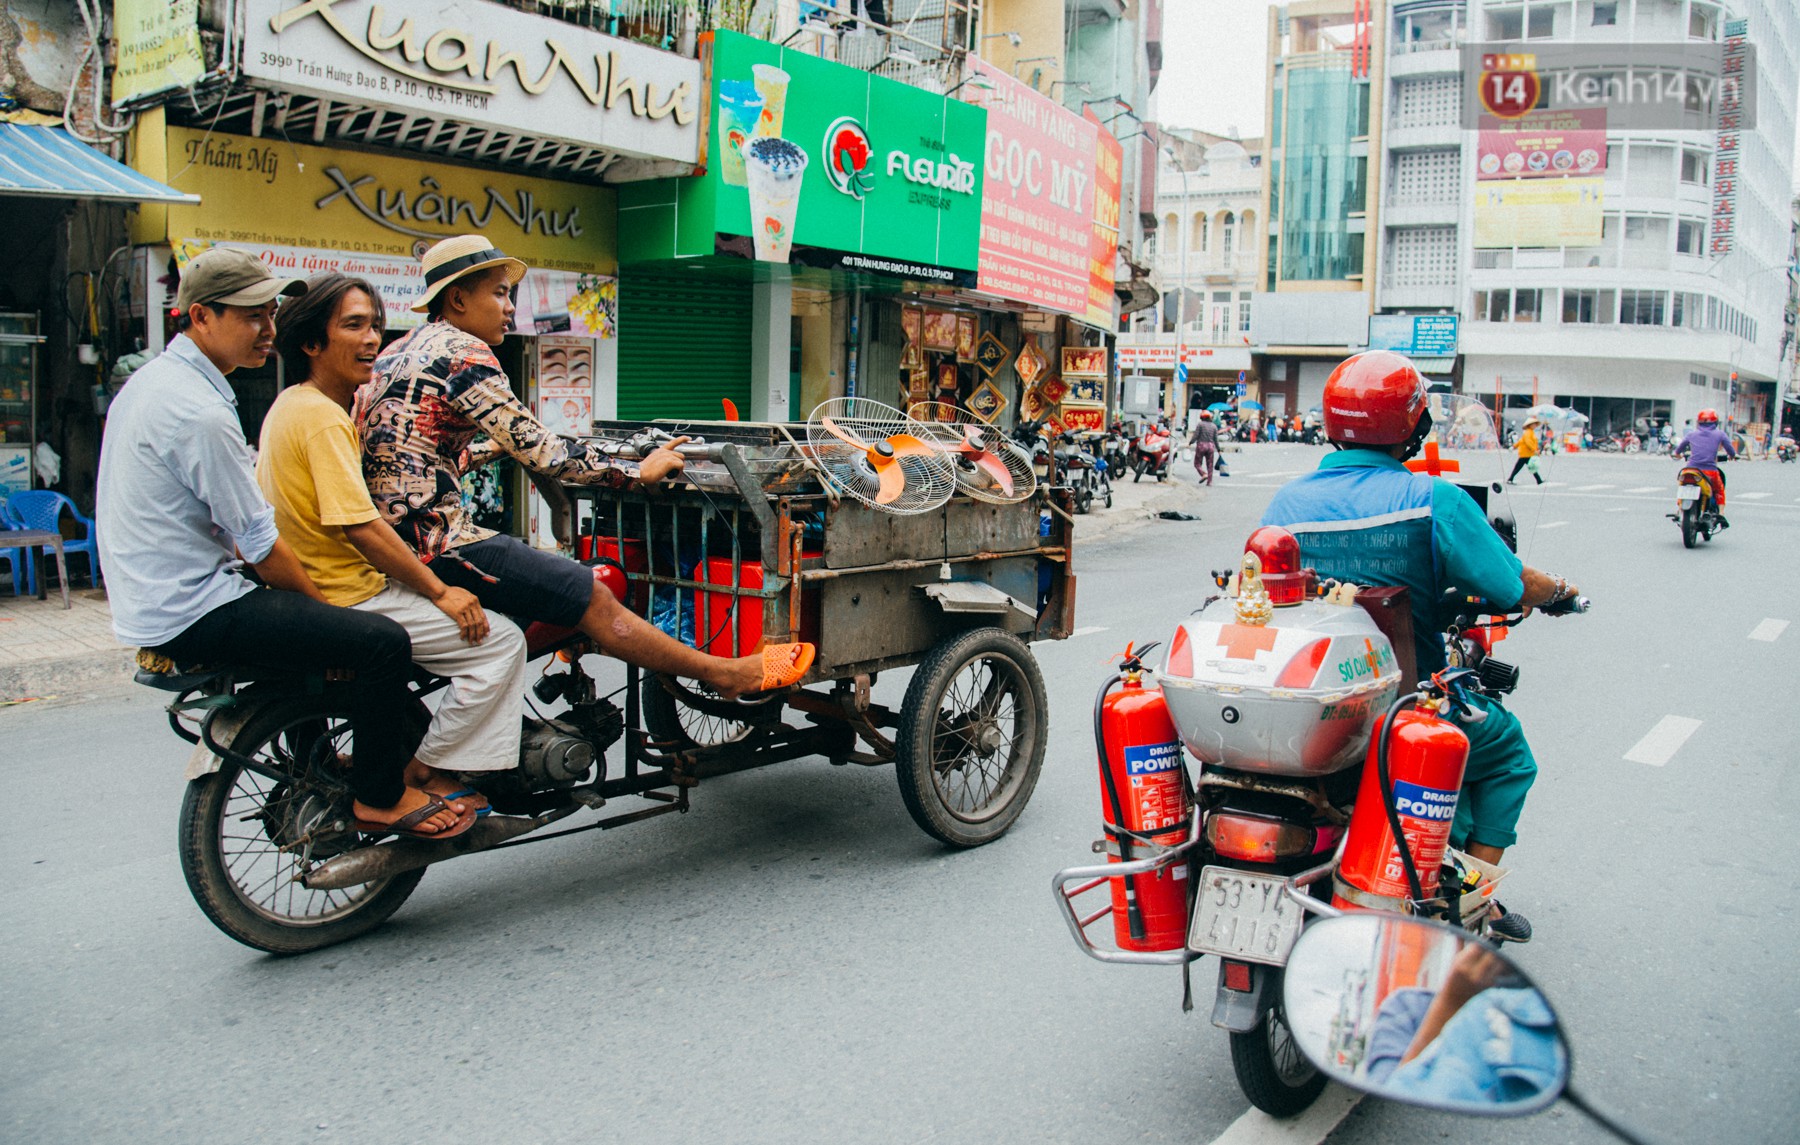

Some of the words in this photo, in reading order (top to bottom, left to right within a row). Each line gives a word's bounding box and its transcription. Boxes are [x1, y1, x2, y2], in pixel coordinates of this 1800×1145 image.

[465, 93, 488, 111] HCM
[185, 138, 244, 170] Thẩm
[246, 147, 279, 184] Mỹ
[985, 128, 1043, 200] GỌC
[908, 190, 952, 211] EXPRESS
[260, 250, 297, 273] Quà
[302, 255, 339, 273] tặng
[1131, 755, 1181, 773] POWD
